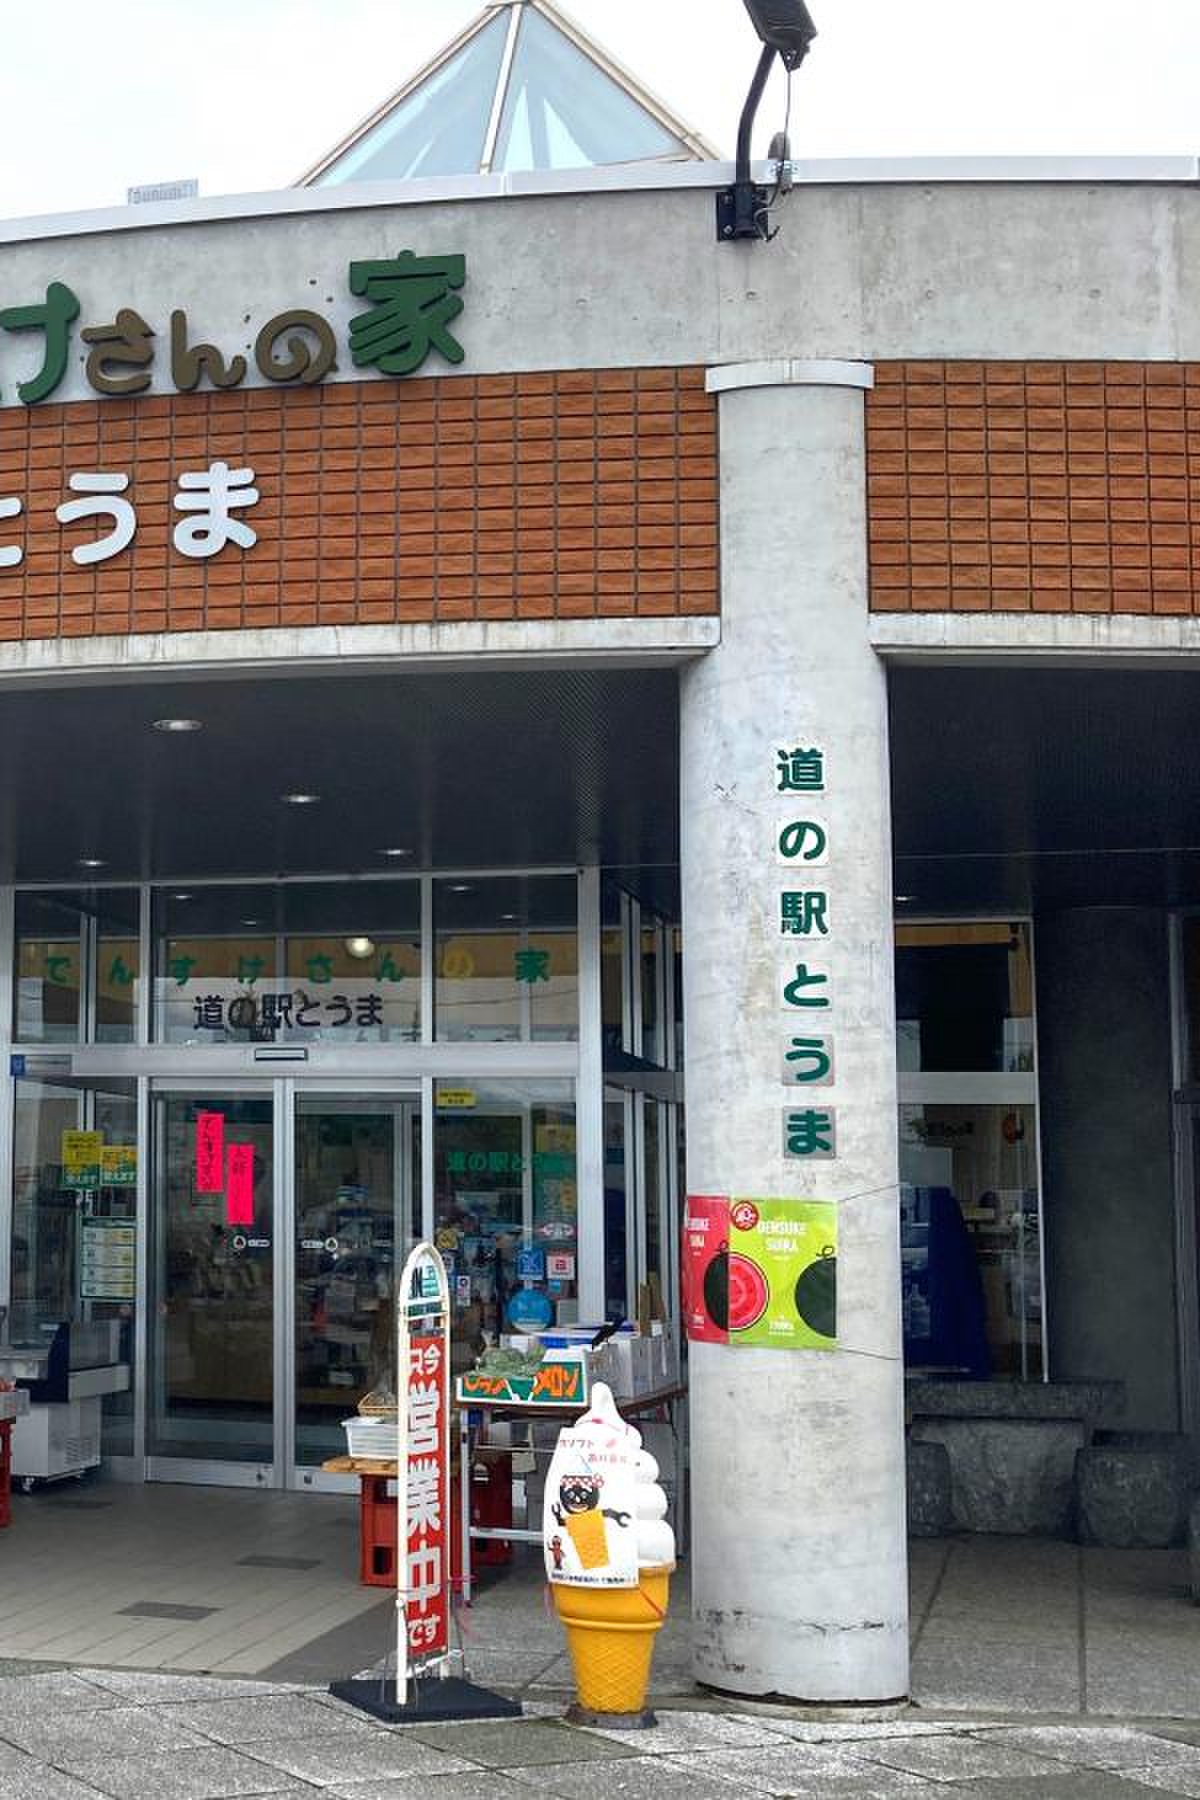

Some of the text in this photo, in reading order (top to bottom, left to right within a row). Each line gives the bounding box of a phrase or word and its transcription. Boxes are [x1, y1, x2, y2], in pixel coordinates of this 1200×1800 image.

[193, 994, 383, 1030] 道の駅とうま
[776, 747, 833, 1156] 道の駅とうま
